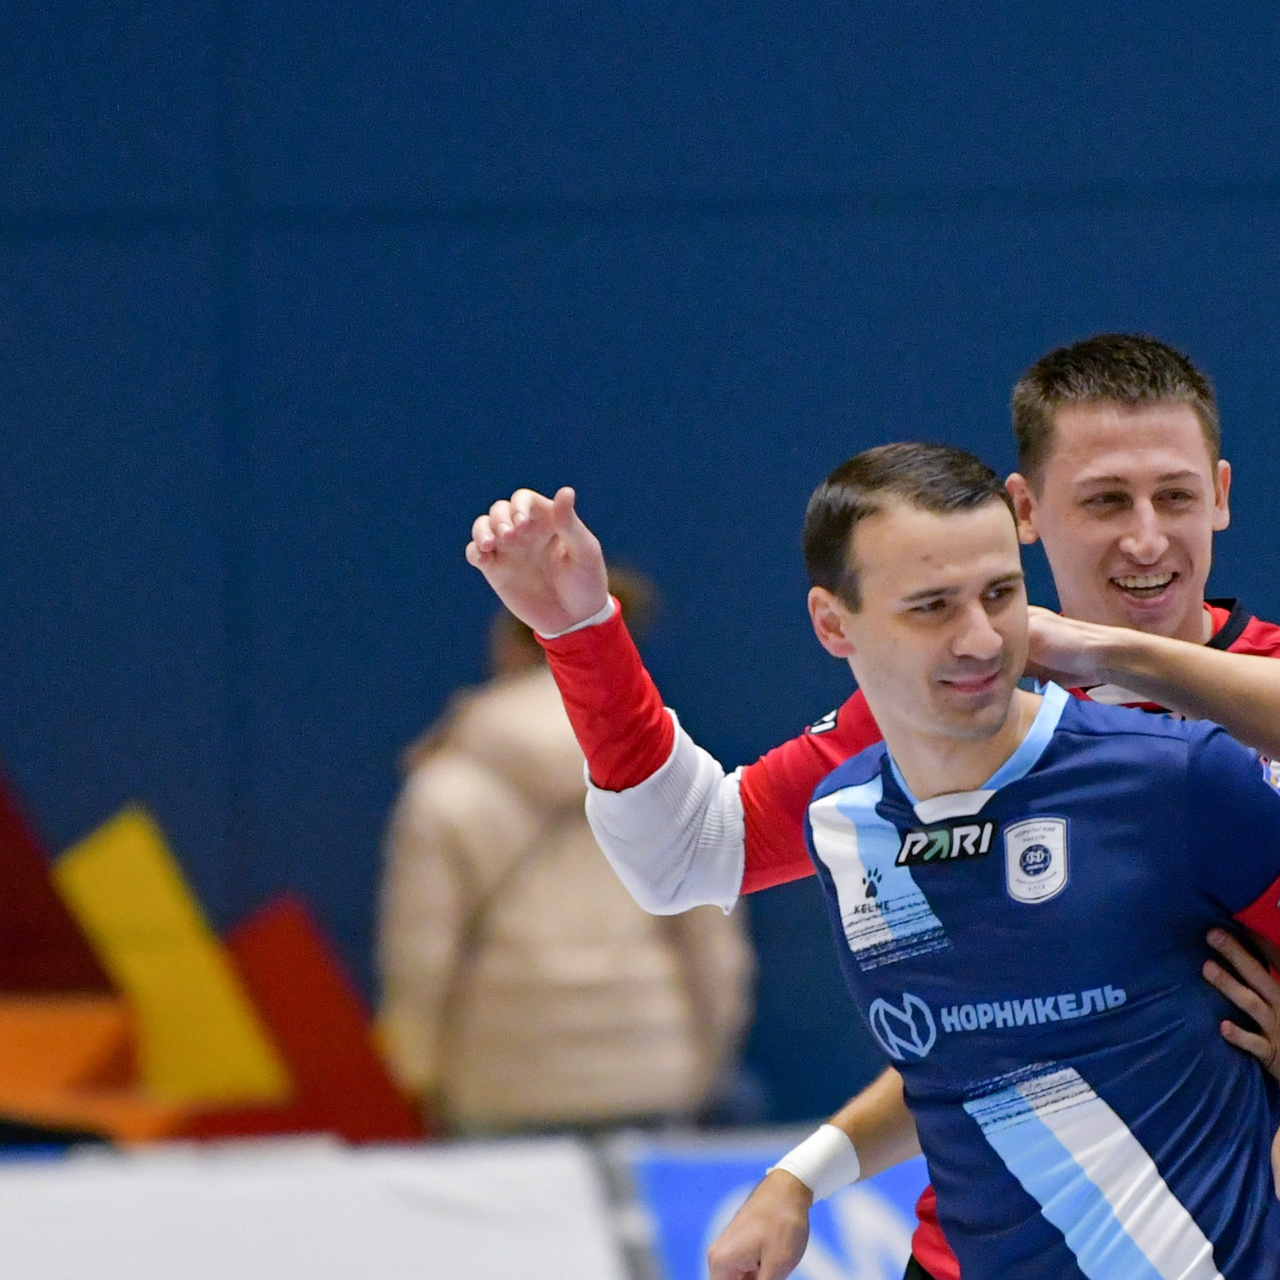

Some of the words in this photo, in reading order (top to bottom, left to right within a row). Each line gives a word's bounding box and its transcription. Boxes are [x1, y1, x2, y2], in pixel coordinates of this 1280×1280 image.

[898, 823, 993, 862] PARI
[854, 900, 890, 914] KELME
[941, 985, 1127, 1032] НОРНИКЕЛЬ
